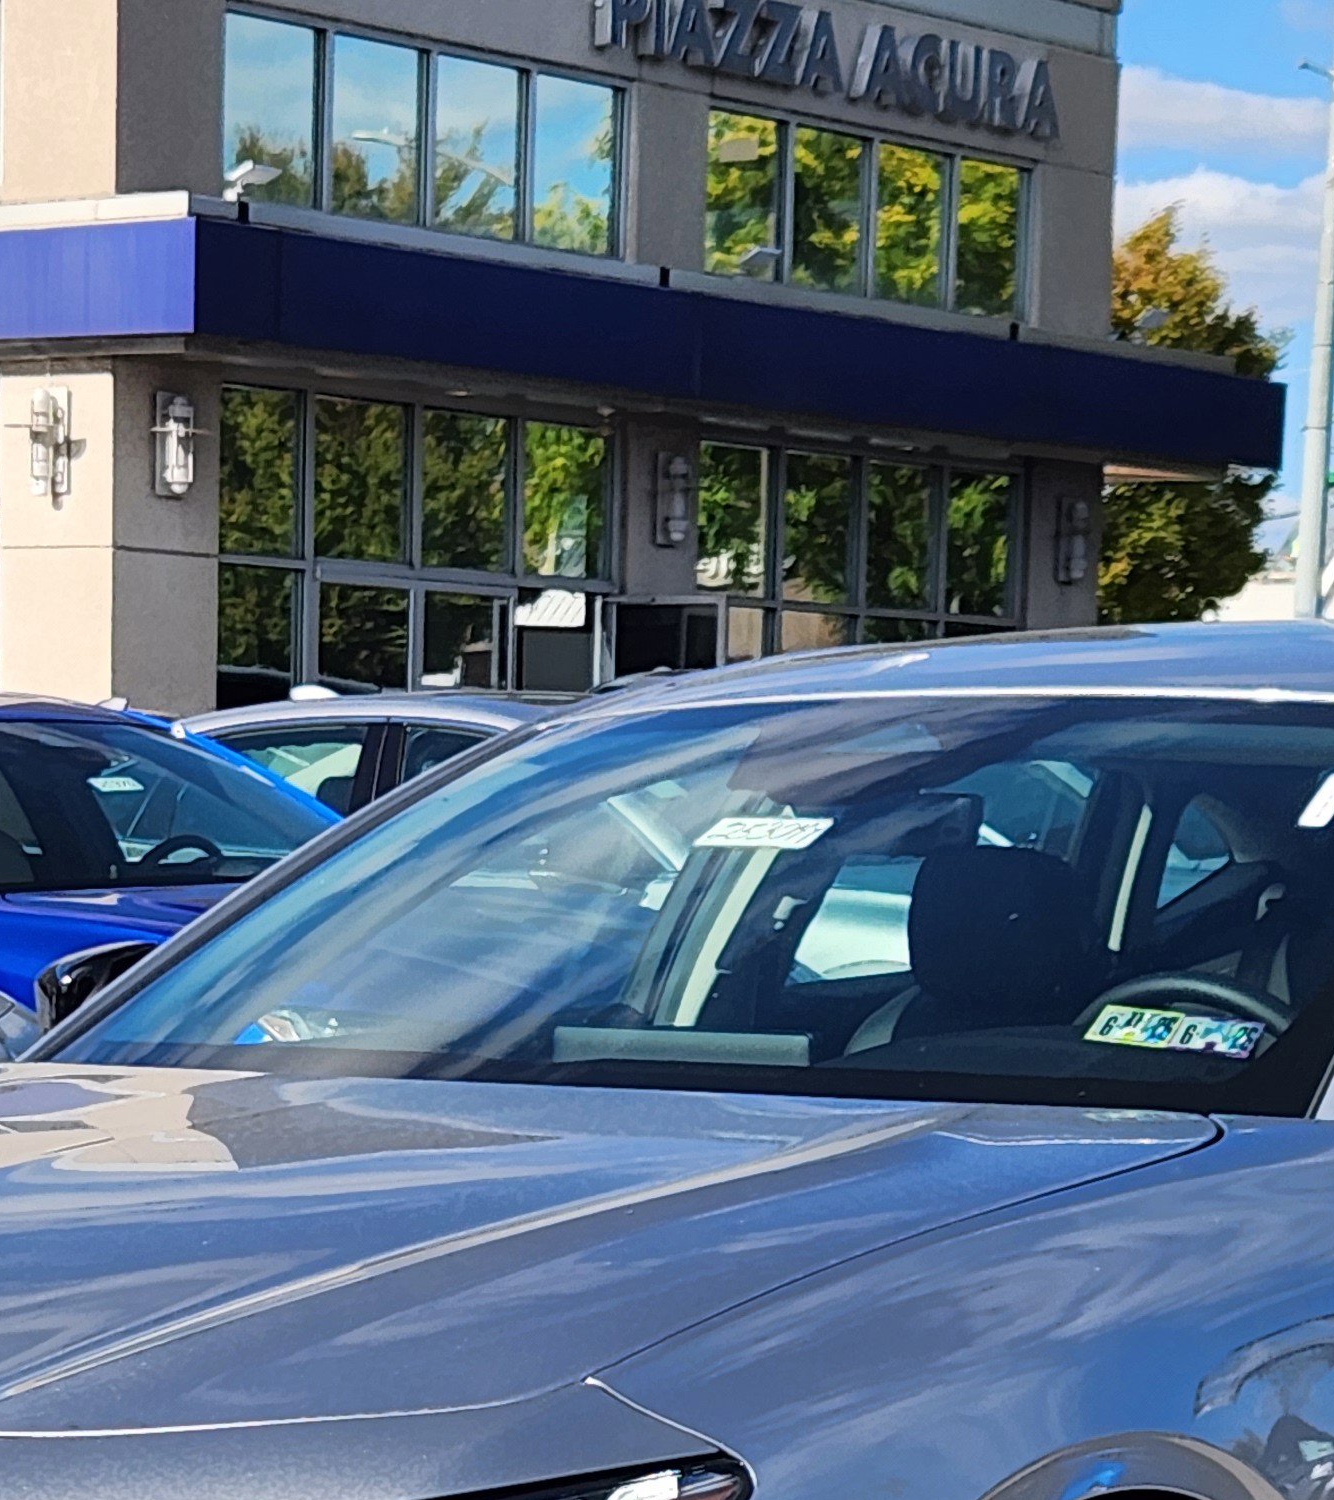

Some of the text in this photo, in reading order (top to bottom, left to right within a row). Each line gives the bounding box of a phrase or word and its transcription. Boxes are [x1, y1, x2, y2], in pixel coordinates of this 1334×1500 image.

[594, 0, 1060, 138] PIAZZA ACURA
[1099, 1016, 1118, 1036] 6
[1179, 1024, 1198, 1044] 6
